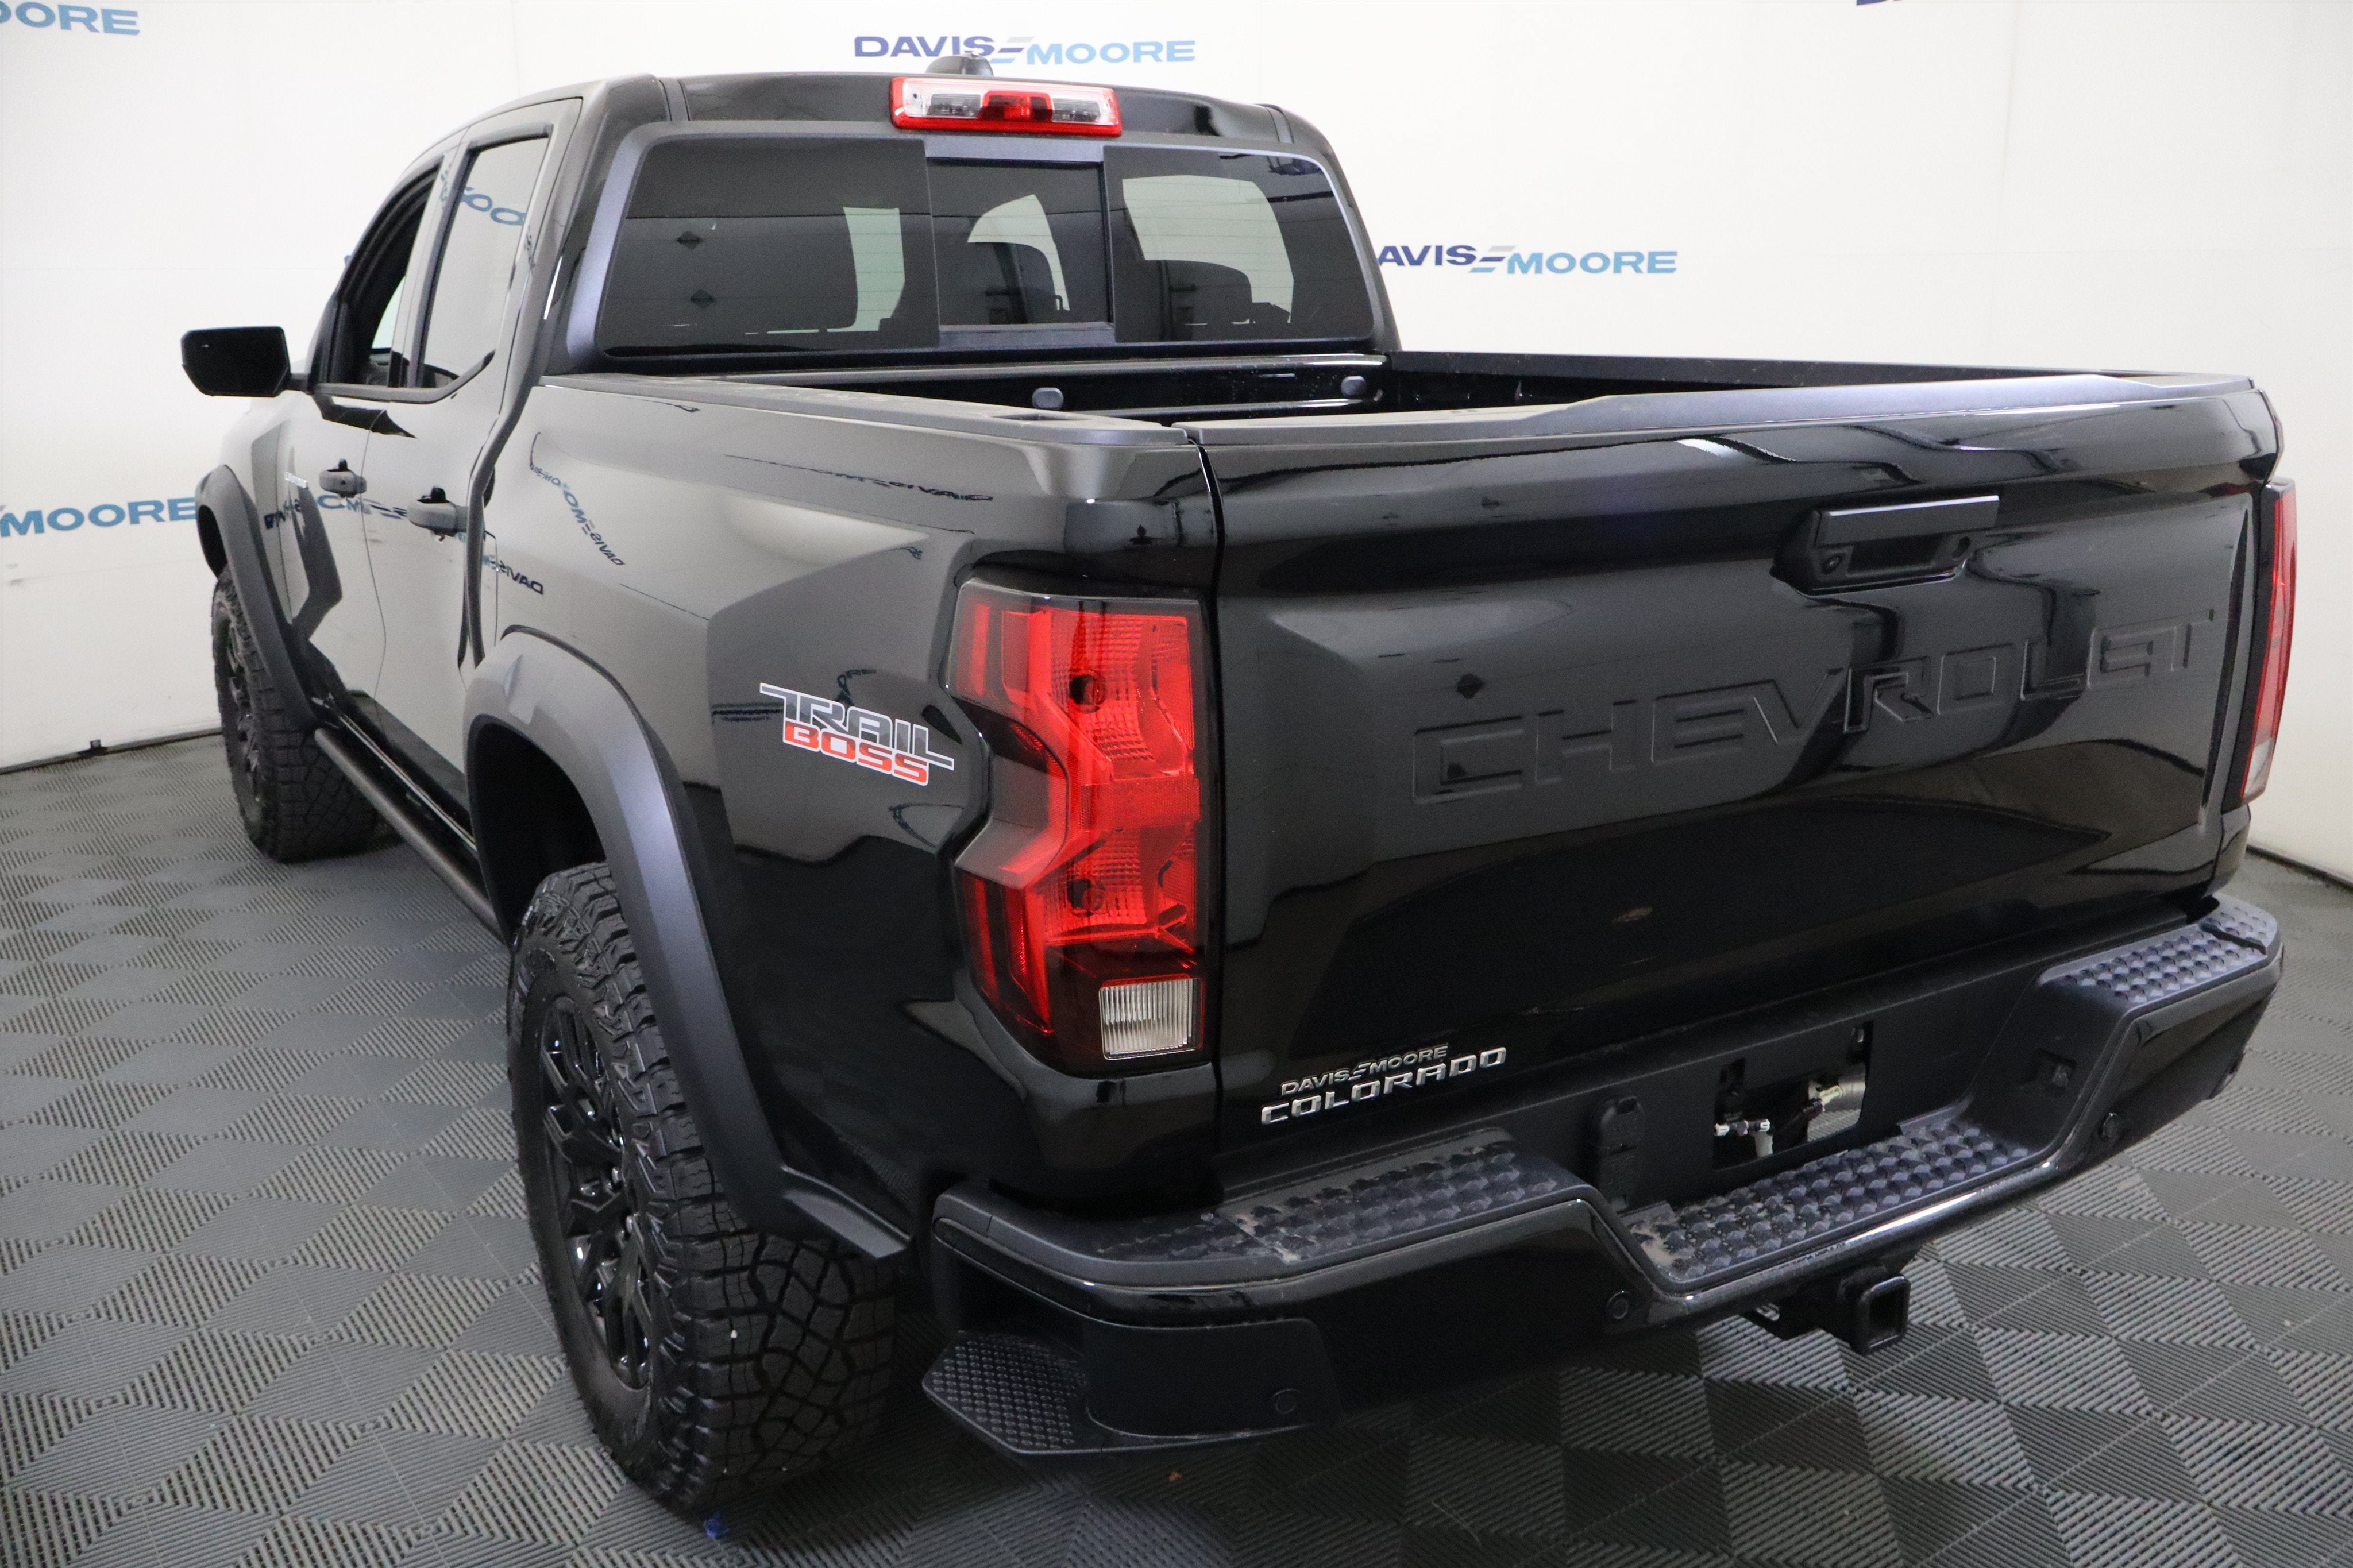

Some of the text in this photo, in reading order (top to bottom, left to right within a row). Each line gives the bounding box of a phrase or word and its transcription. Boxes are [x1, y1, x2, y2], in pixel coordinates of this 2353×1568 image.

[0, 1, 140, 36] ORE
[854, 36, 1196, 65] DAVIS MOORE
[1378, 245, 1678, 275] AVIS MOORE
[0, 497, 198, 537] MOORE
[759, 682, 955, 771] TRAIL
[1411, 608, 2216, 805] CHEVROLET
[782, 719, 929, 786] BOSS
[1261, 1046, 1507, 1125] COLORADO
[1281, 1042, 1449, 1096] DAVIS MOORE
